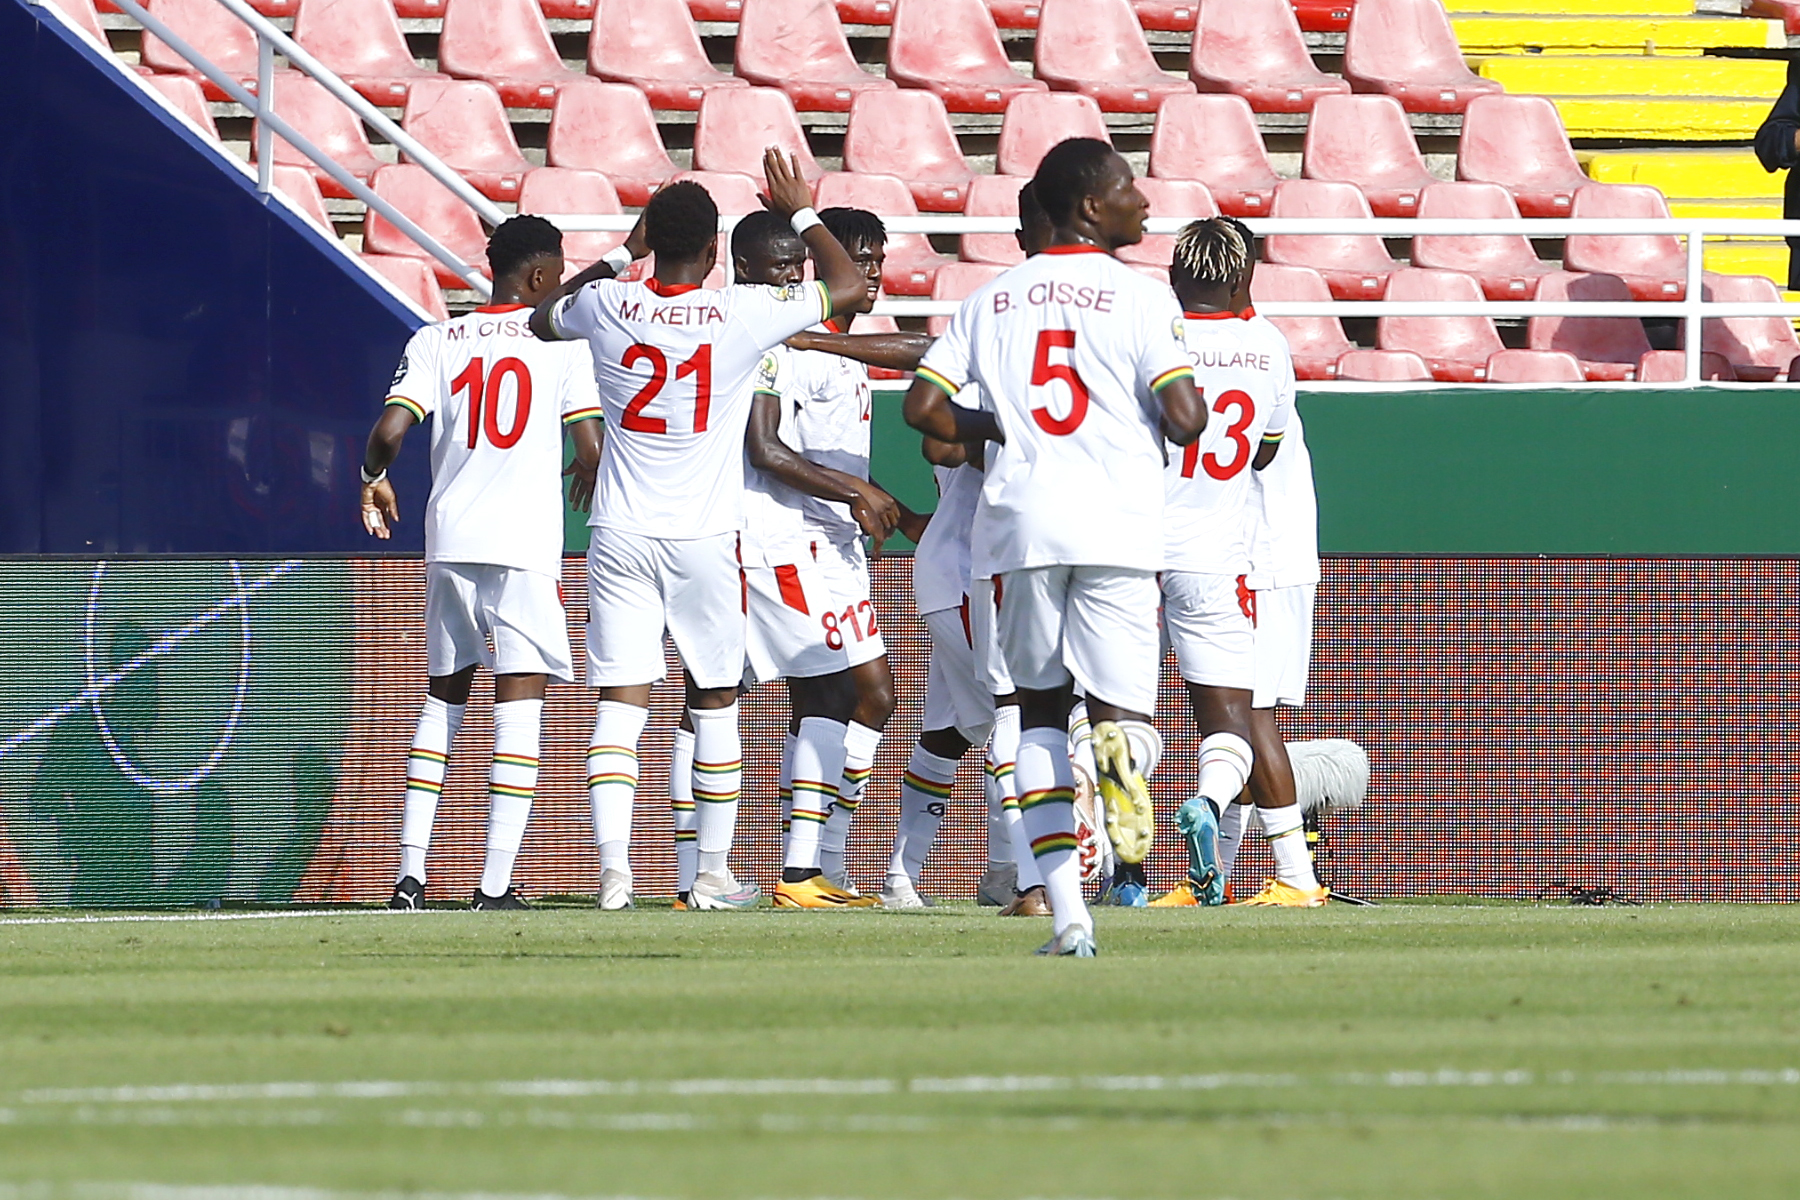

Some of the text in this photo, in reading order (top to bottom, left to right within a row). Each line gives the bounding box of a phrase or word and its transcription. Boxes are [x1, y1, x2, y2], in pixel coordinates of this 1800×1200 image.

[619, 300, 724, 326] M. KEITA
[994, 280, 1116, 315] B. CISSE
[447, 324, 470, 341] M.
[450, 356, 533, 450] 10
[620, 342, 712, 435] 21
[1030, 328, 1090, 437] 5
